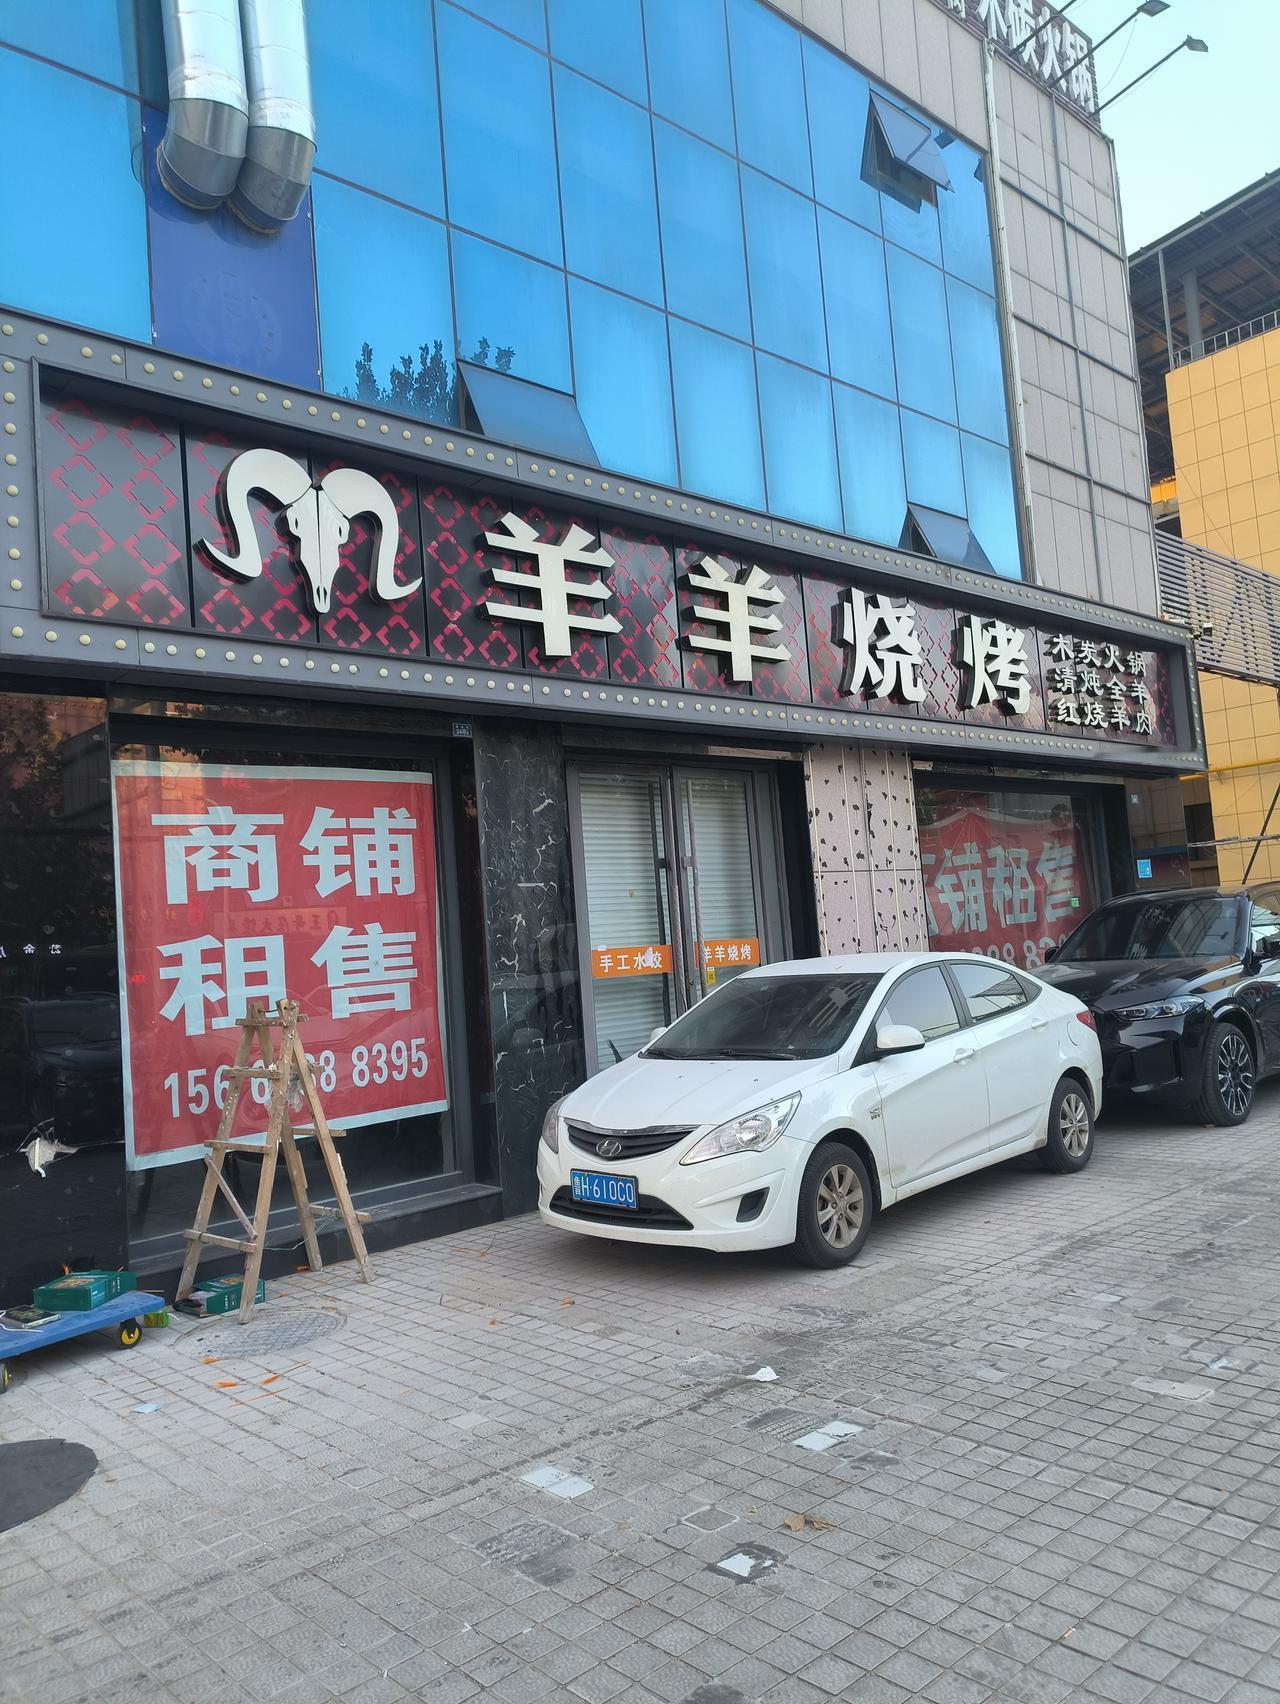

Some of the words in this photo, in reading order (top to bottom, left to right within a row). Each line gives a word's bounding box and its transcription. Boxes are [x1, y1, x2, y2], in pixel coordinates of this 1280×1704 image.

[484, 511, 1032, 715] 羊羊烧烤
[1051, 633, 1147, 678] 木炭火锅
[1054, 666, 1148, 704] 清炖全羊
[1057, 698, 1153, 735] 红烧羊肉
[151, 805, 417, 904] 商铺
[922, 841, 1074, 937] 铺租售
[156, 921, 418, 1037] 租售
[352, 1037, 428, 1088] 8395
